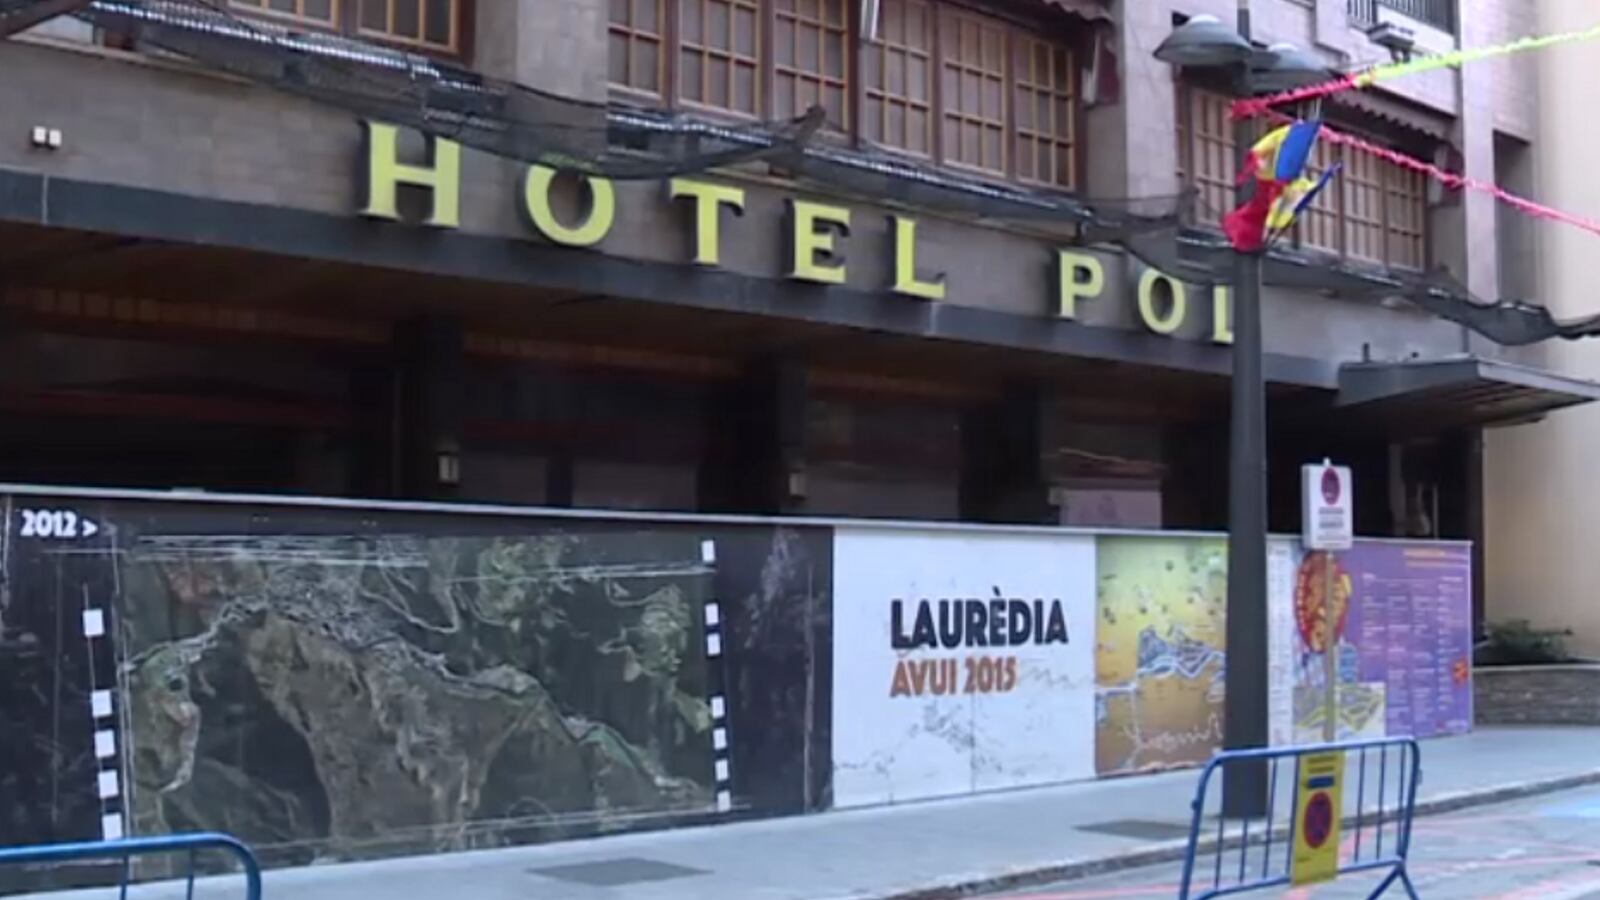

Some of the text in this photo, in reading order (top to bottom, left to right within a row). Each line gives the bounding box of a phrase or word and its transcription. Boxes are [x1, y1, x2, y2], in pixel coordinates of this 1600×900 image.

[359, 121, 946, 300] HOTEL
[20, 508, 78, 537] 2012
[890, 586, 1069, 650] LAURÈDIA
[889, 655, 1018, 699] AVUI 2015
